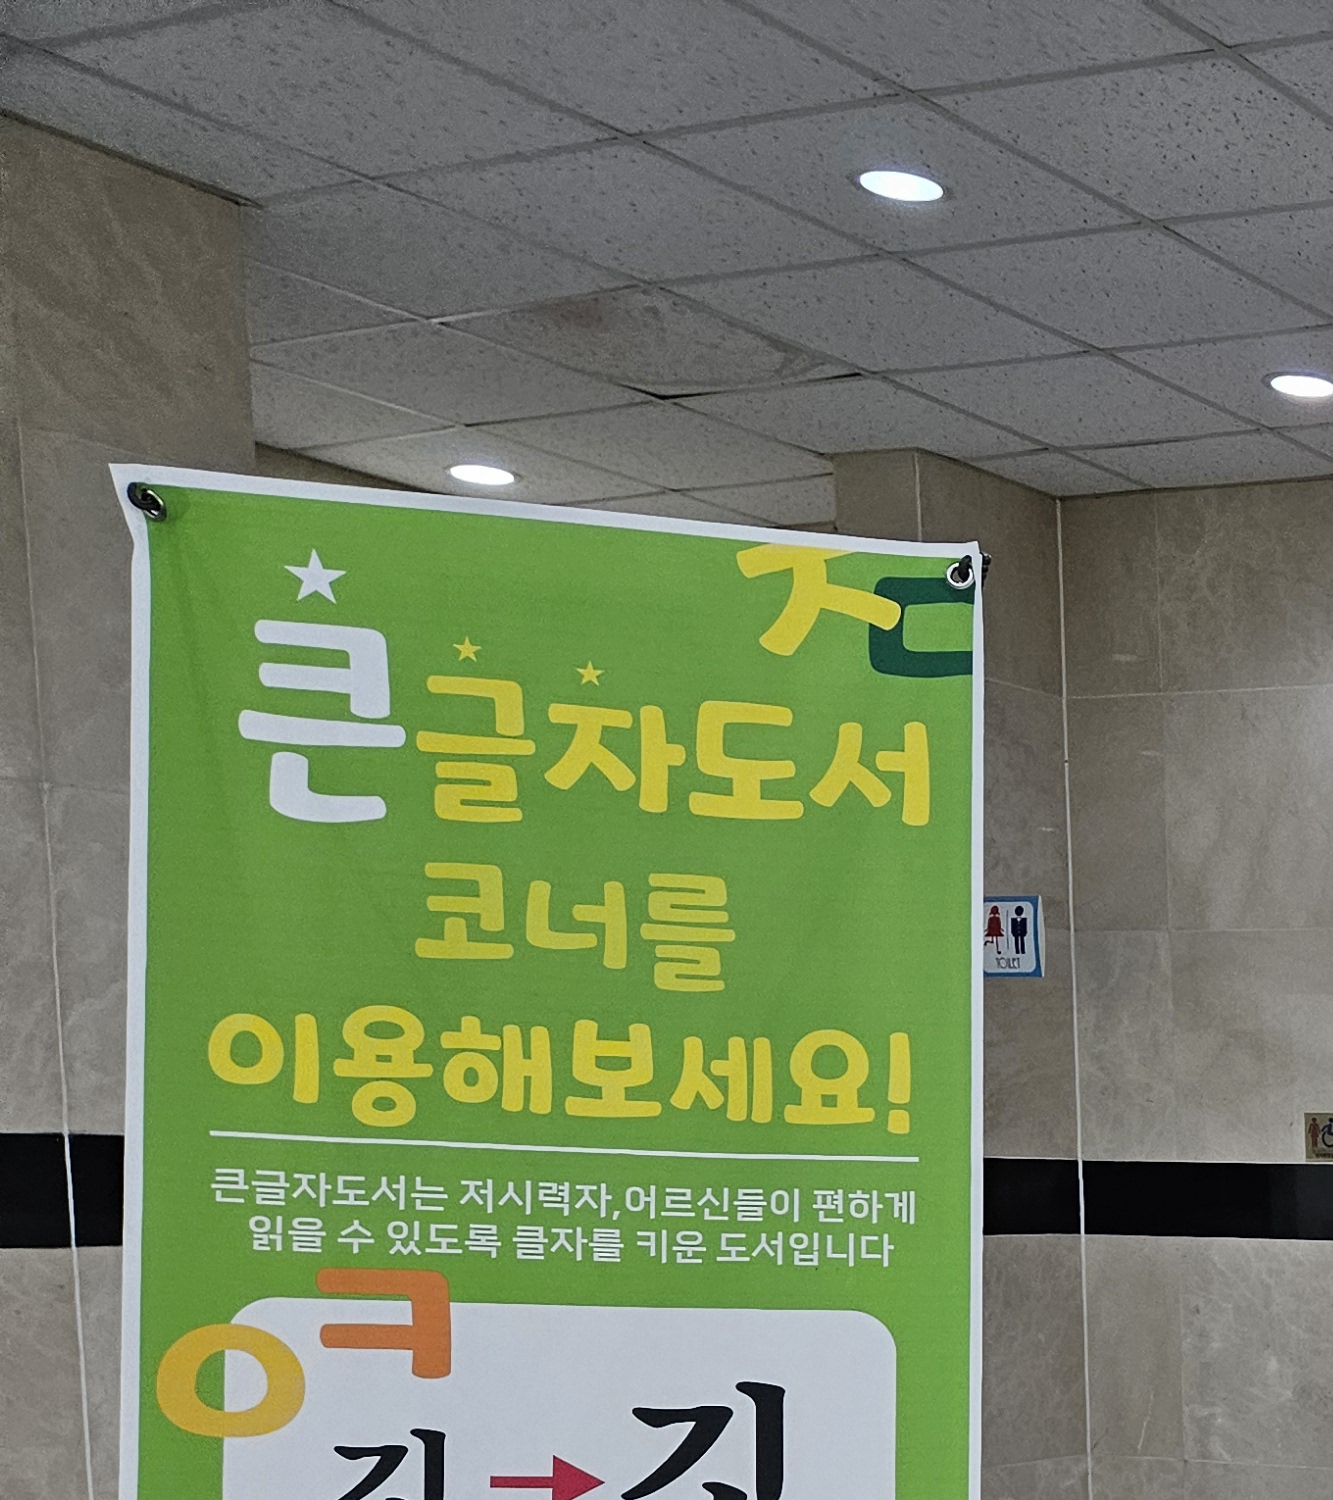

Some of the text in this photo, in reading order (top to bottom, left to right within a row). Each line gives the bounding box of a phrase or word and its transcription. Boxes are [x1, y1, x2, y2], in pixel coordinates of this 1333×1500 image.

[238, 620, 929, 825] 큰글자도서
[415, 863, 736, 992] 코너를
[996, 958, 1020, 969] TOILET
[208, 1005, 911, 1134] 이용해보세요!
[211, 1169, 915, 1224] 큰글자도서는 저시력자,어르신들이 편하게
[249, 1216, 326, 1252] 읽을
[337, 1220, 374, 1254] 수
[387, 1221, 501, 1258] 있도록
[637, 1230, 705, 1263] 키운
[717, 1232, 894, 1267] 도서입니다
